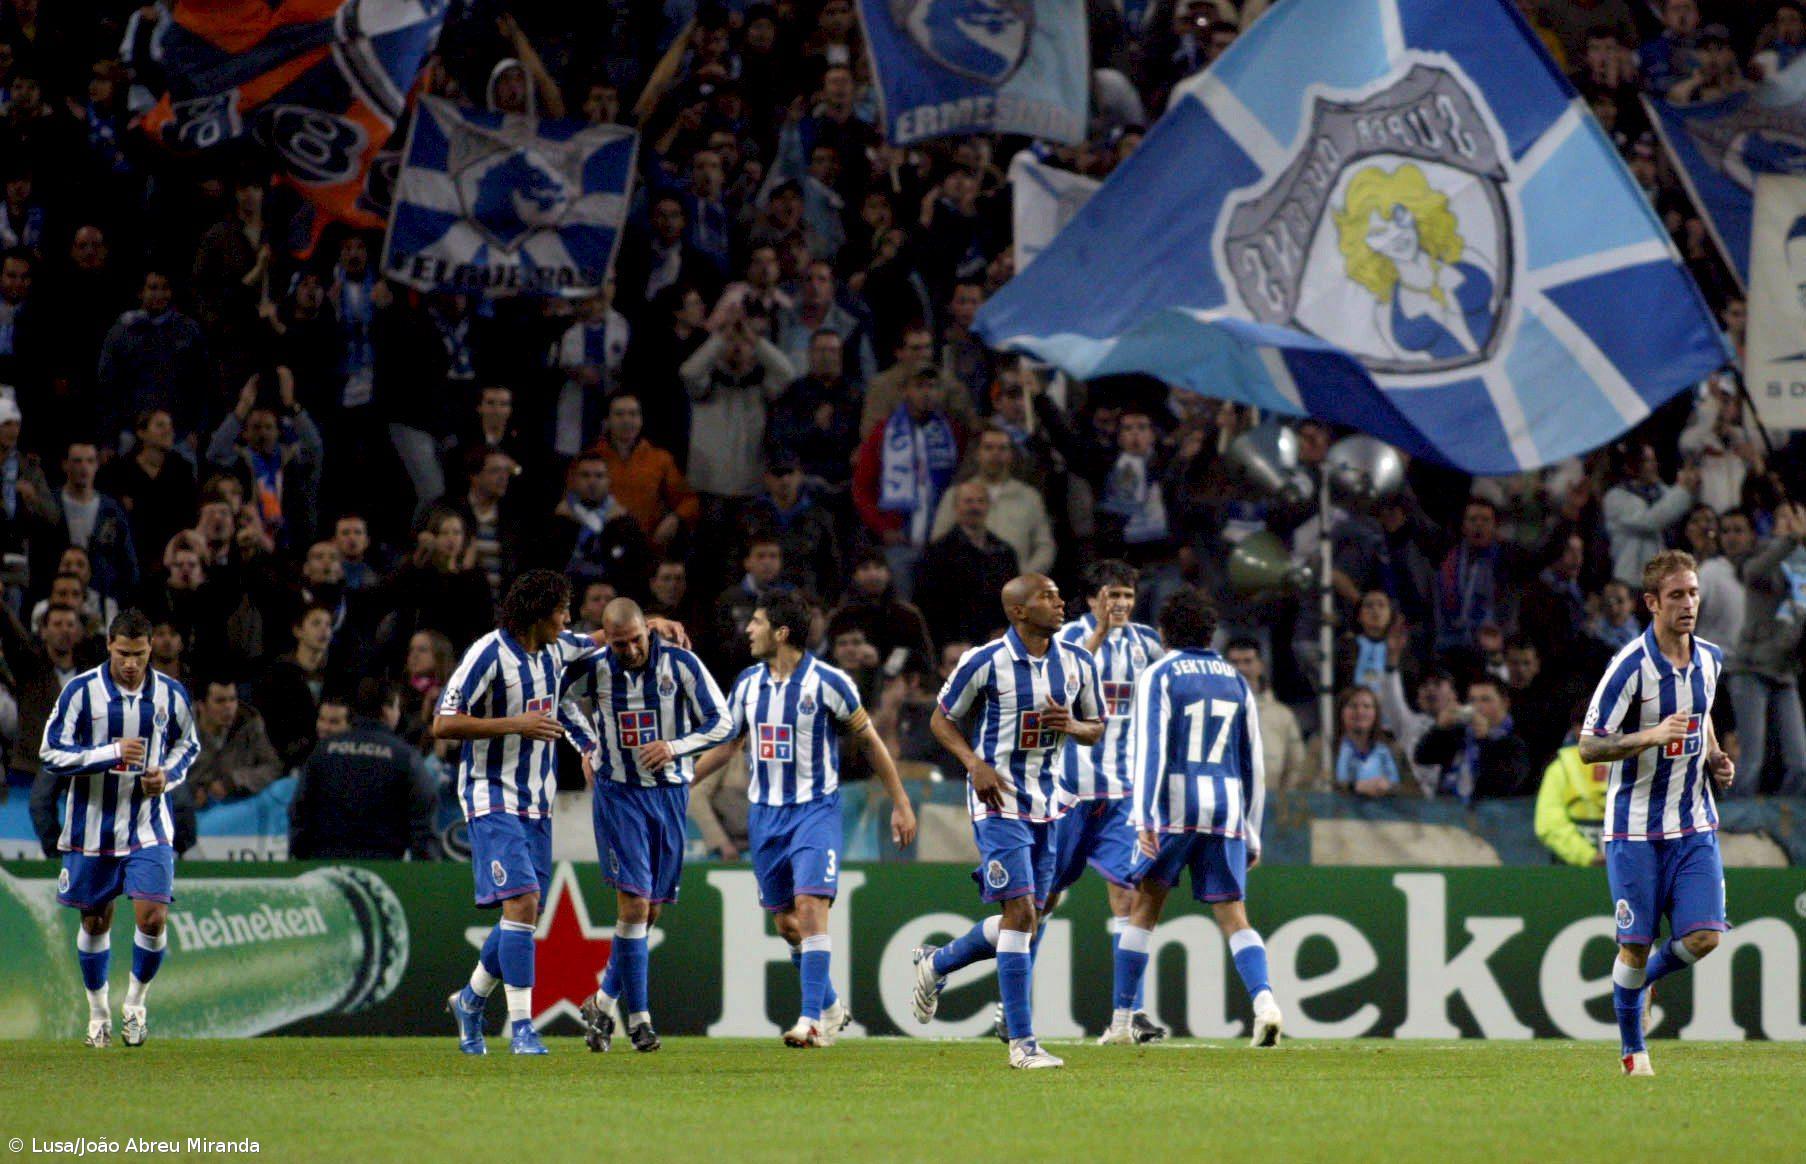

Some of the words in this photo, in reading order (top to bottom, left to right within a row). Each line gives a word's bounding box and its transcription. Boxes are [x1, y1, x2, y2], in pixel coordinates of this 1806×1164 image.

[1184, 699, 1239, 763] 17
[326, 740, 394, 759] POLICIA
[763, 745, 786, 757] PT
[1671, 740, 1697, 753] PT
[826, 849, 836, 876] 3
[168, 900, 329, 951] Heineken
[707, 869, 1806, 1039] Heineken
